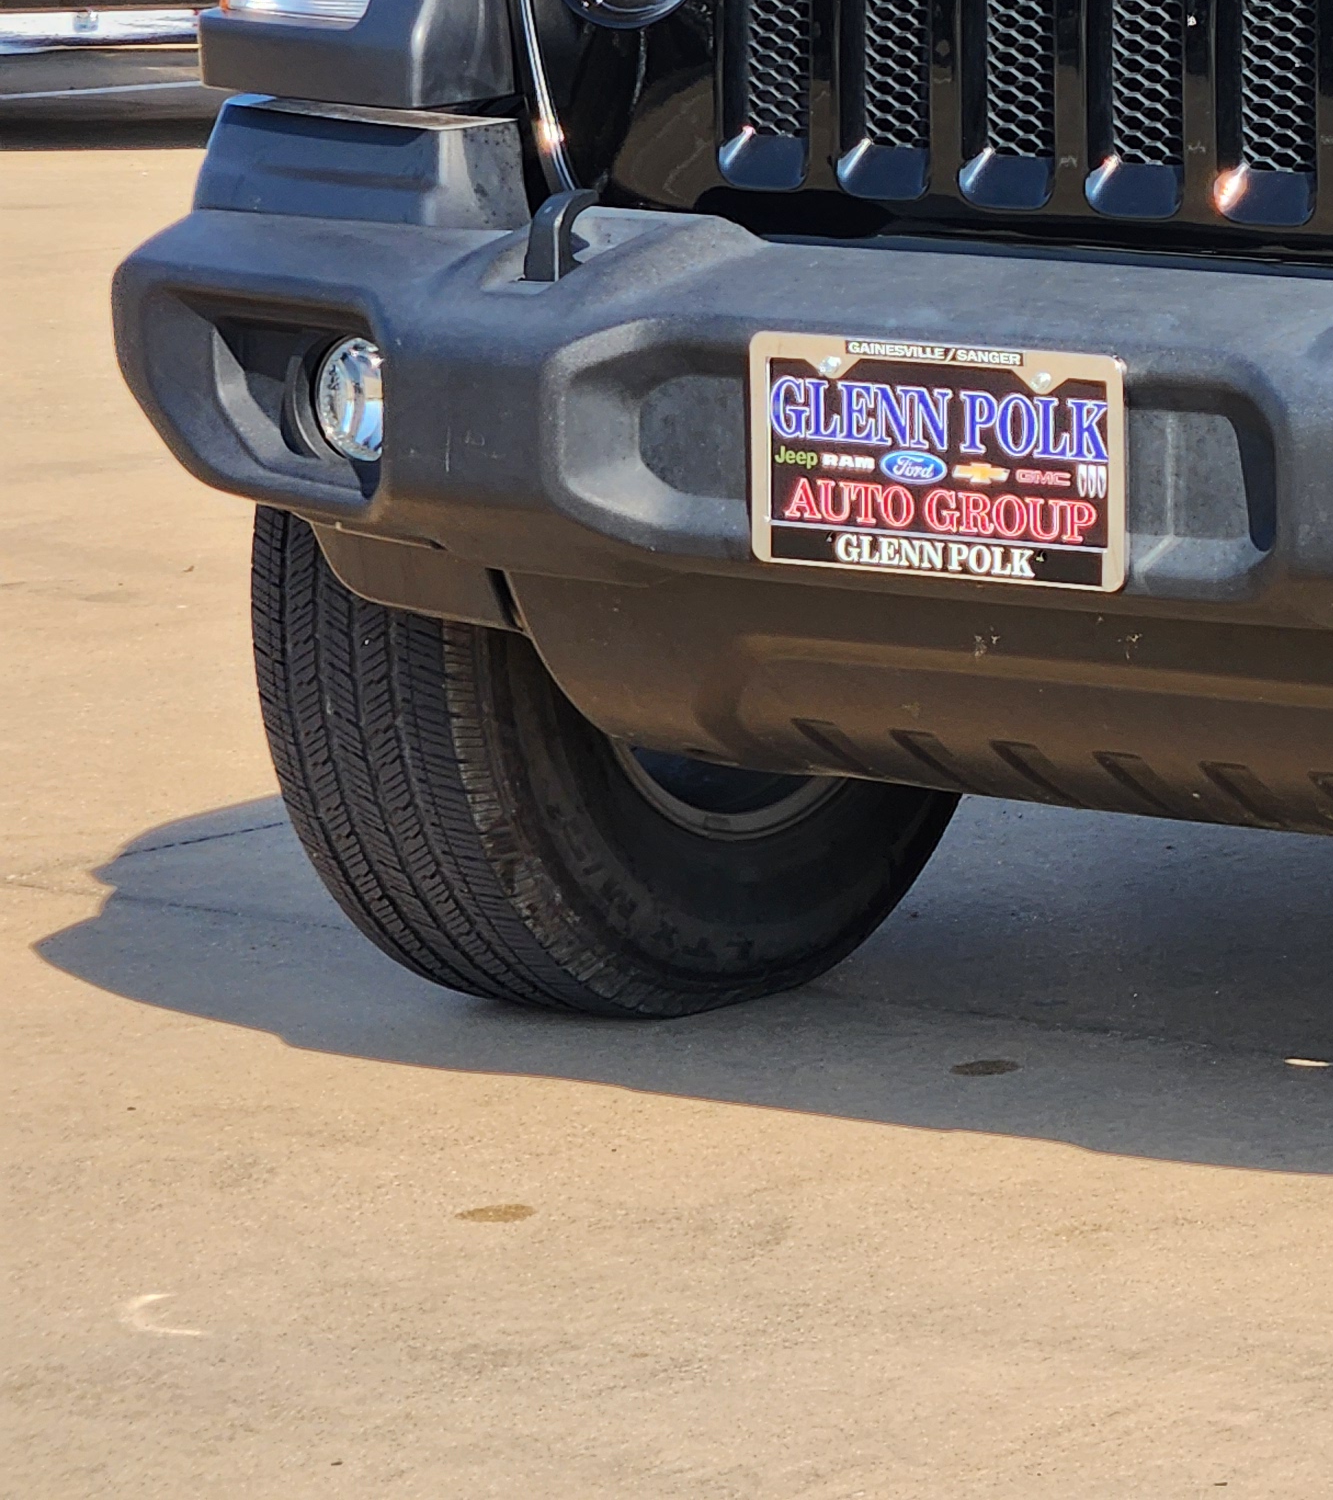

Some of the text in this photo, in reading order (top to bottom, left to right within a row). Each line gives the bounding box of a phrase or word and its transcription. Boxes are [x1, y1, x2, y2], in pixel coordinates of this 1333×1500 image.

[956, 349, 1022, 366] SANGER
[770, 374, 1109, 462] GLENN POLK
[775, 445, 1072, 487] Jeep RAM Ford GMC
[785, 477, 1097, 543] AUTO GROUP
[835, 533, 1036, 579] GLENN POLK
